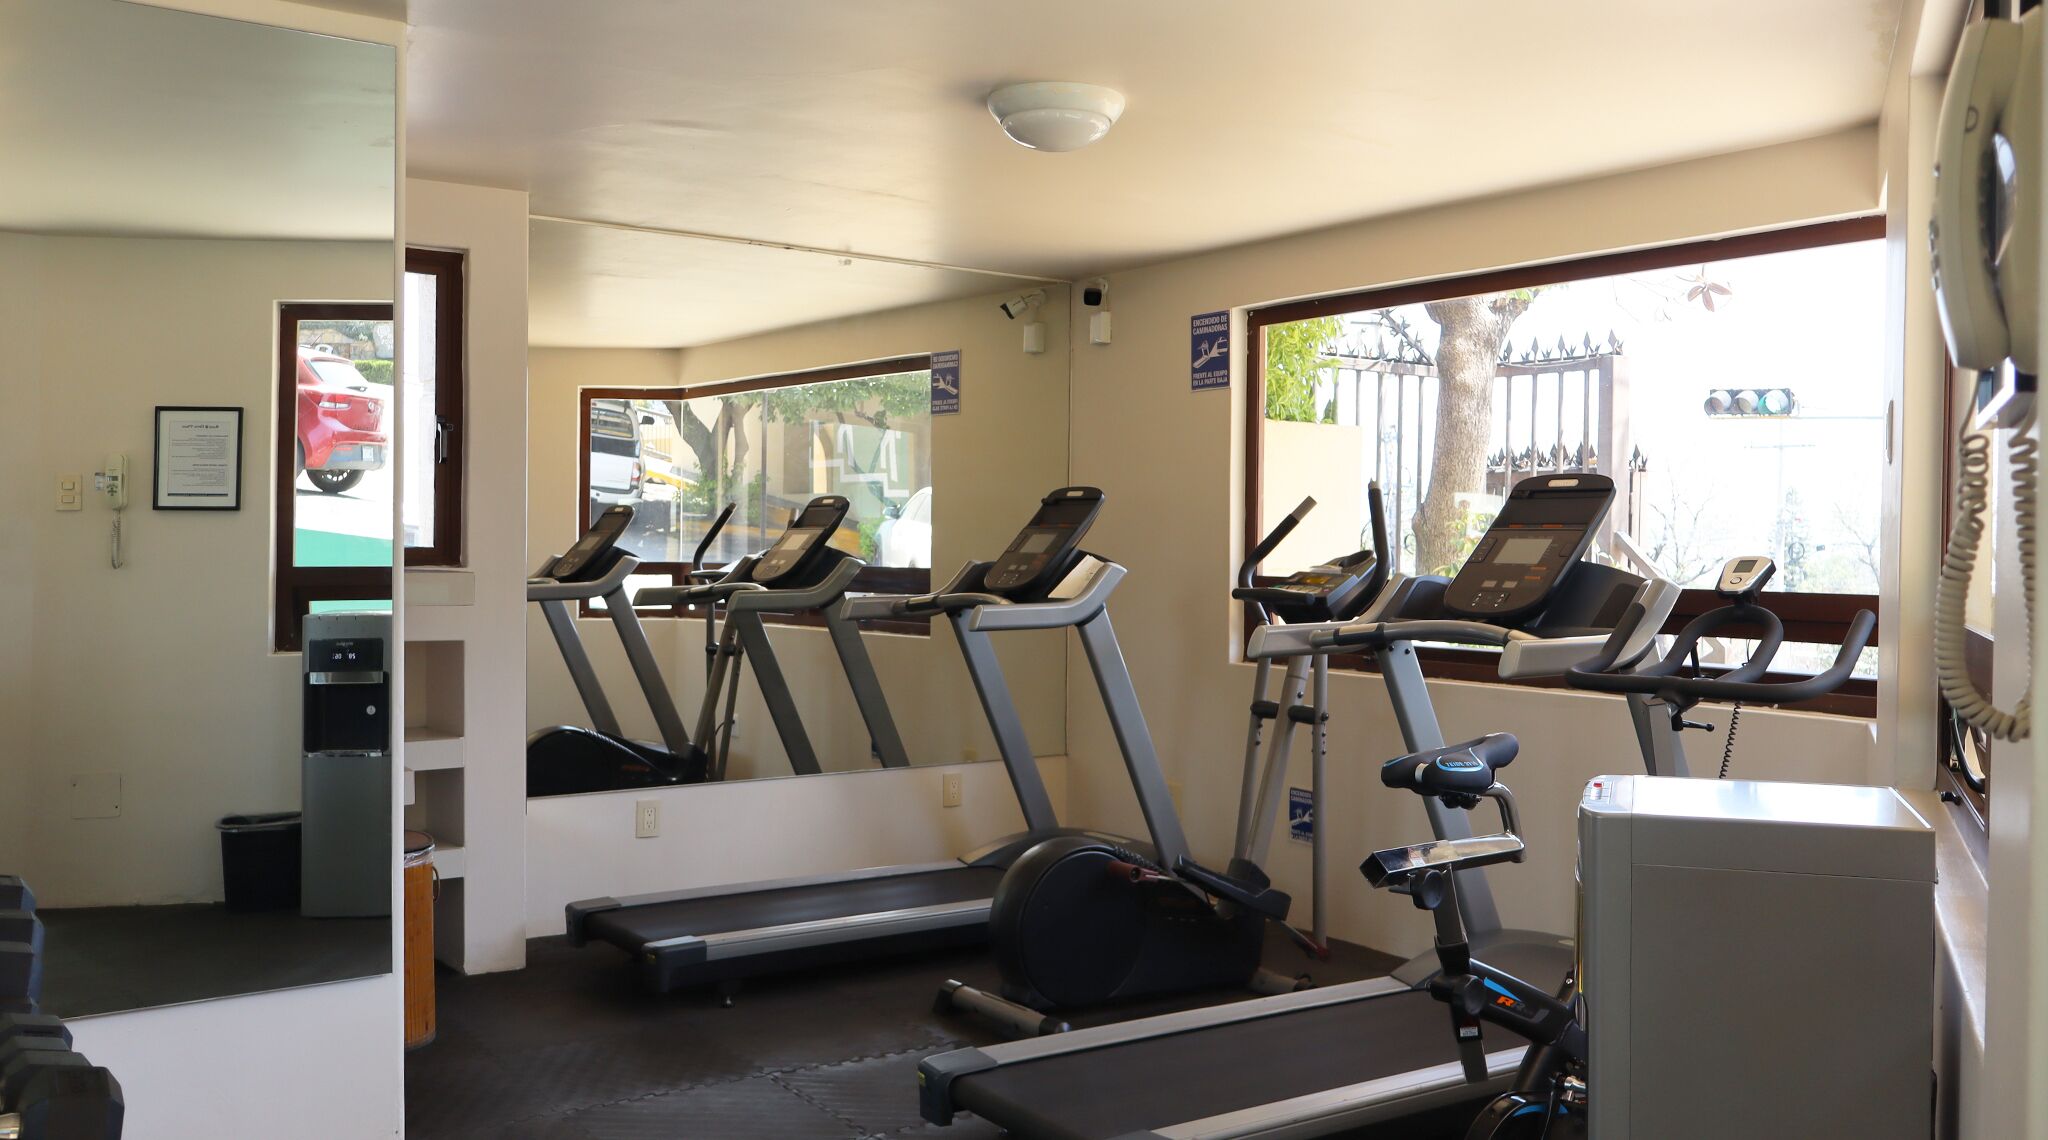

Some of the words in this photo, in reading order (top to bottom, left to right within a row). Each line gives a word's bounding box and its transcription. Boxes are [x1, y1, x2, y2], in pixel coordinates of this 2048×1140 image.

[1193, 316, 1220, 326] ENCENDIDO
[1221, 315, 1228, 323] DE
[1193, 324, 1228, 335] CAMINADORAS
